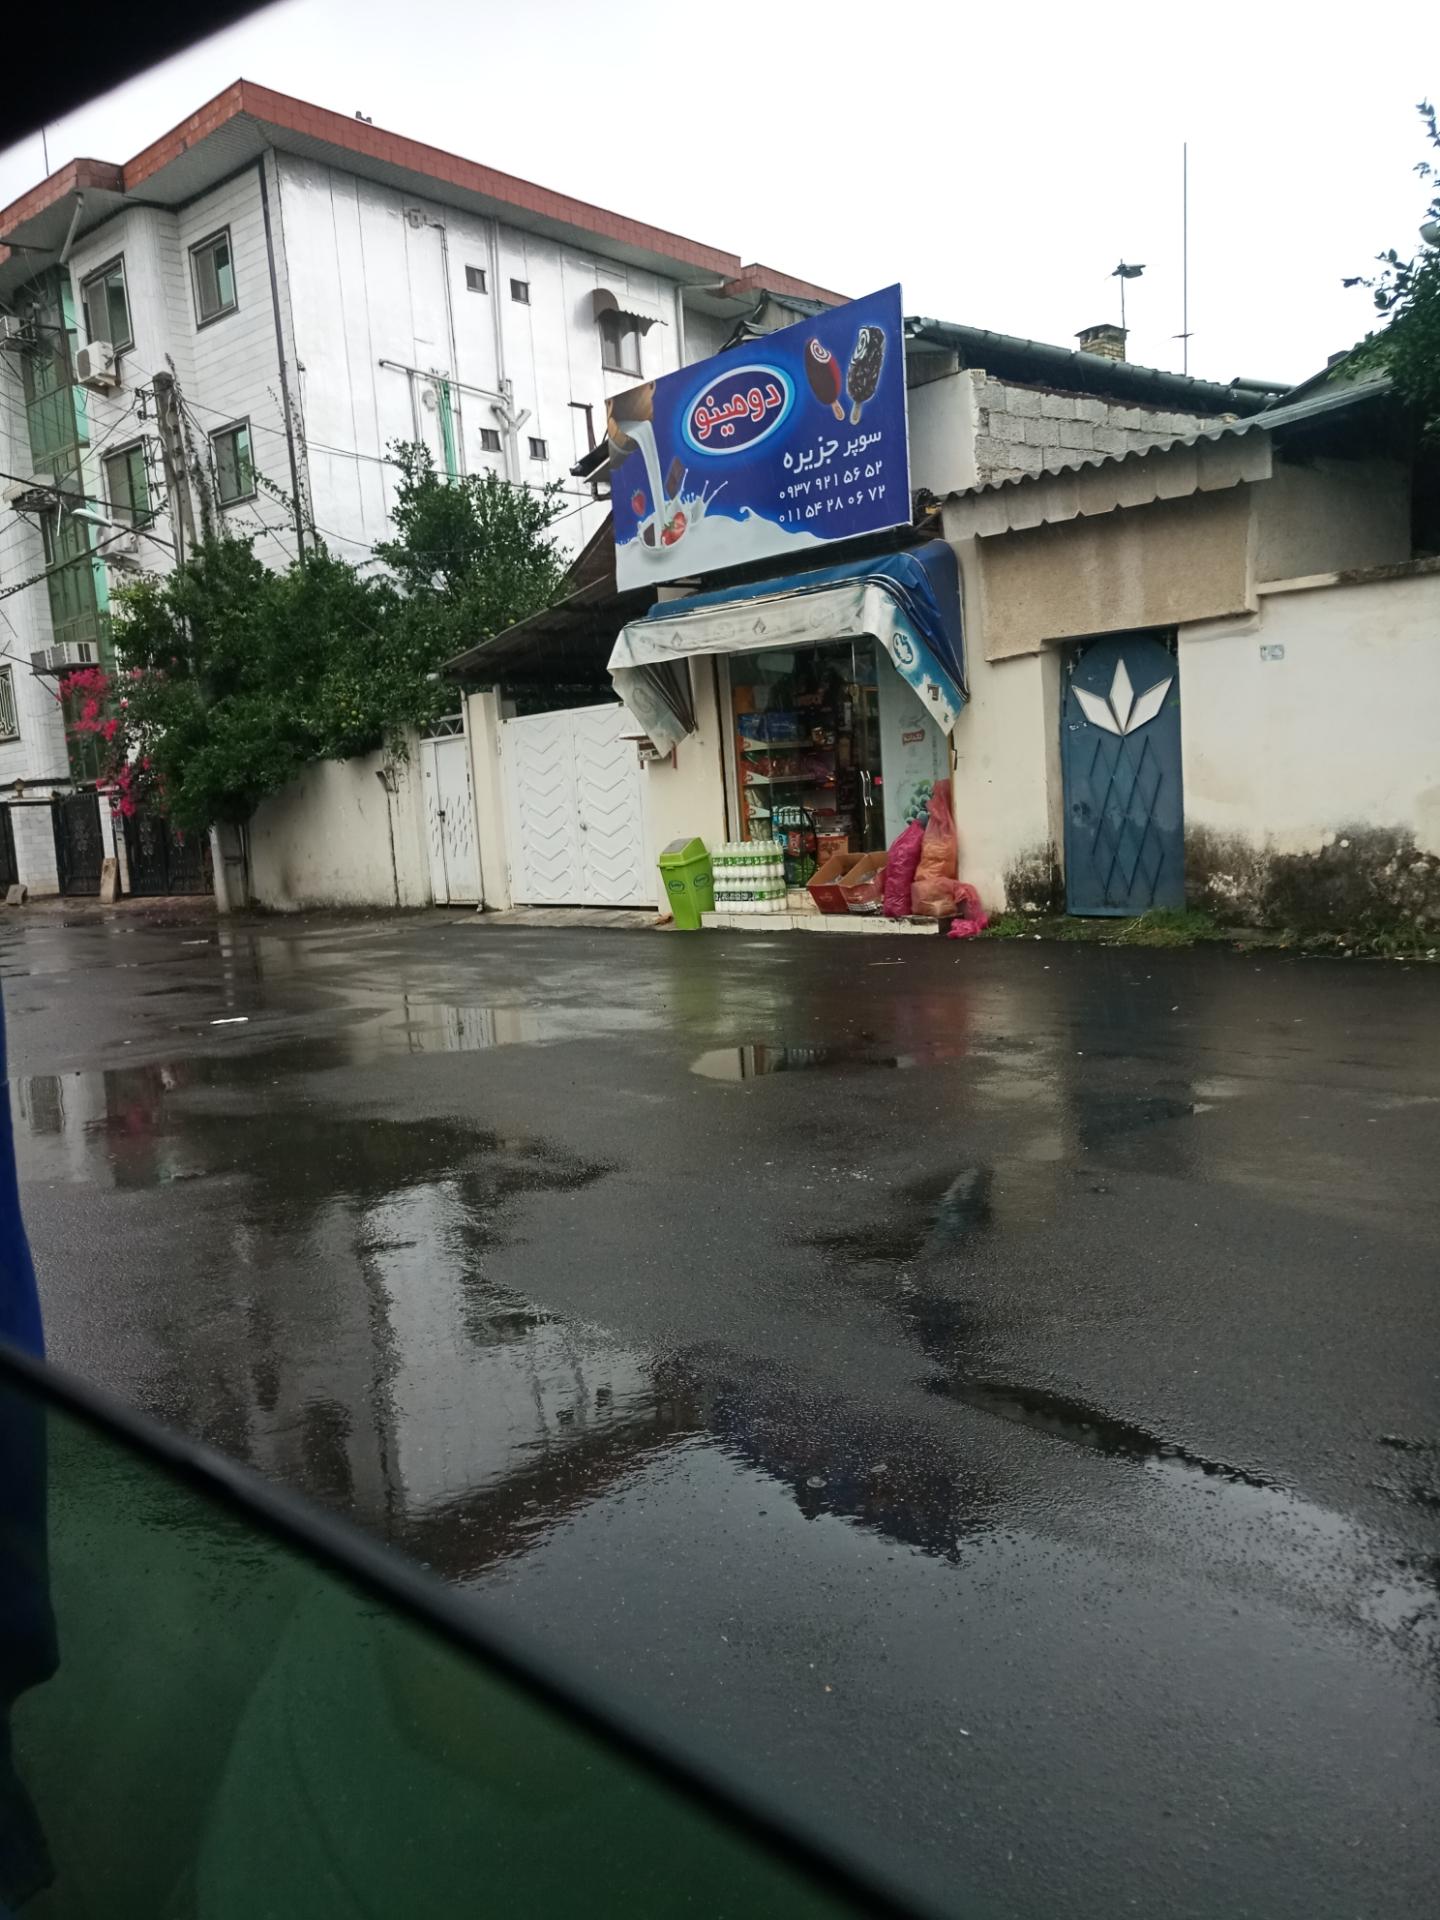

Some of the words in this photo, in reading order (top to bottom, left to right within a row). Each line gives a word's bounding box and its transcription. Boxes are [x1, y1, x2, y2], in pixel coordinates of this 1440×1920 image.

[694, 383, 782, 441] دومینو
[783, 436, 839, 474] جزیره
[843, 431, 882, 457] سوپر
[779, 481, 811, 499] ۰۹۳۷
[815, 473, 838, 491] ۹۲۱
[843, 467, 861, 484] ۵۶
[865, 460, 882, 478] ۵۲
[826, 496, 844, 513] ۲۸
[848, 491, 864, 505] ۰۶
[868, 485, 886, 501] ۷۲
